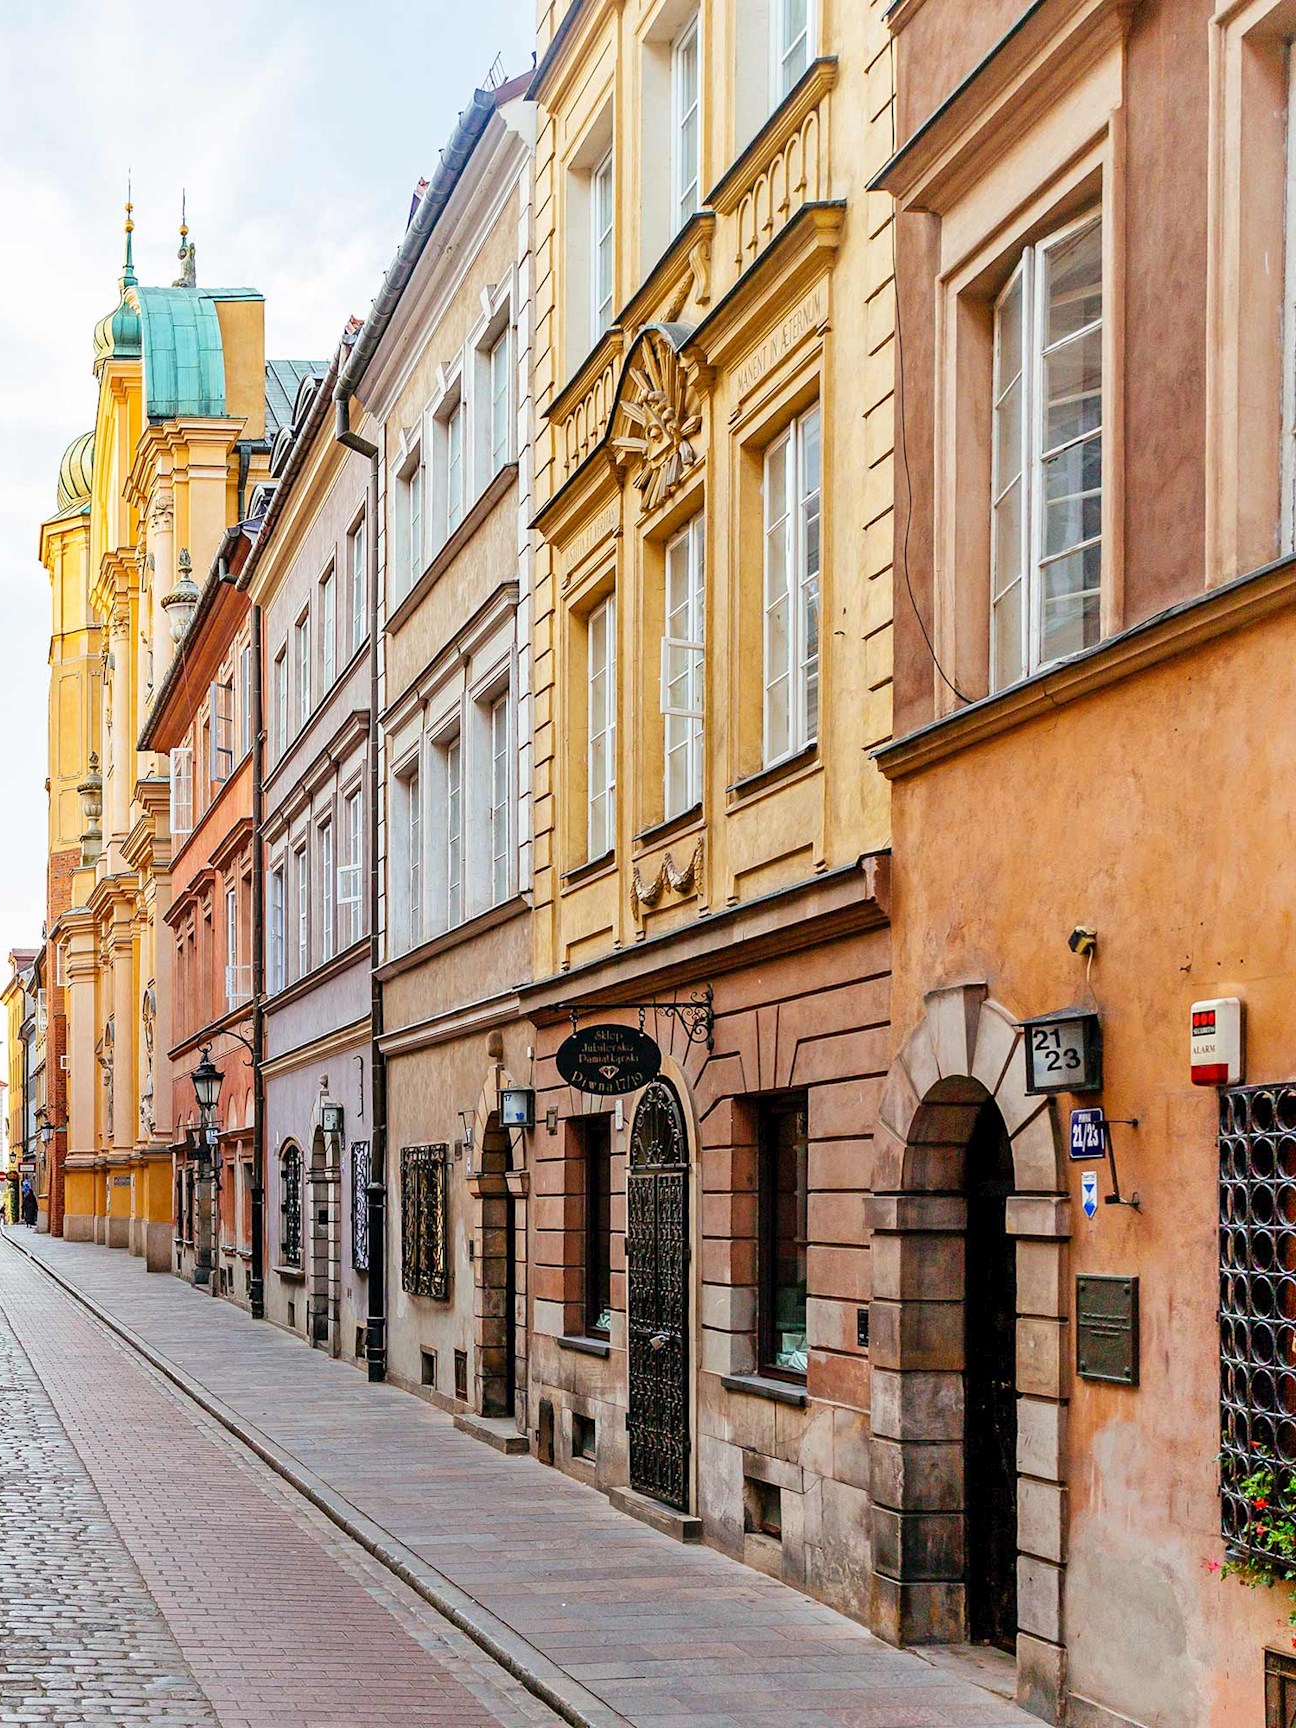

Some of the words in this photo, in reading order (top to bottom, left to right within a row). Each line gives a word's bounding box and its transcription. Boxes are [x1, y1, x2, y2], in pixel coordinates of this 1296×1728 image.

[738, 345, 767, 397] MANENT
[770, 334, 779, 364] IN
[594, 1030, 623, 1043] Sklep
[1033, 1028, 1061, 1050] 21
[1045, 1048, 1081, 1071] 23
[1193, 1045, 1216, 1055] ALARM
[571, 1071, 613, 1092] Piwna
[615, 1072, 644, 1091] 17/19
[504, 1094, 512, 1102] 17
[515, 1112, 524, 1121] 19
[1072, 1123, 1100, 1152] 21/23
